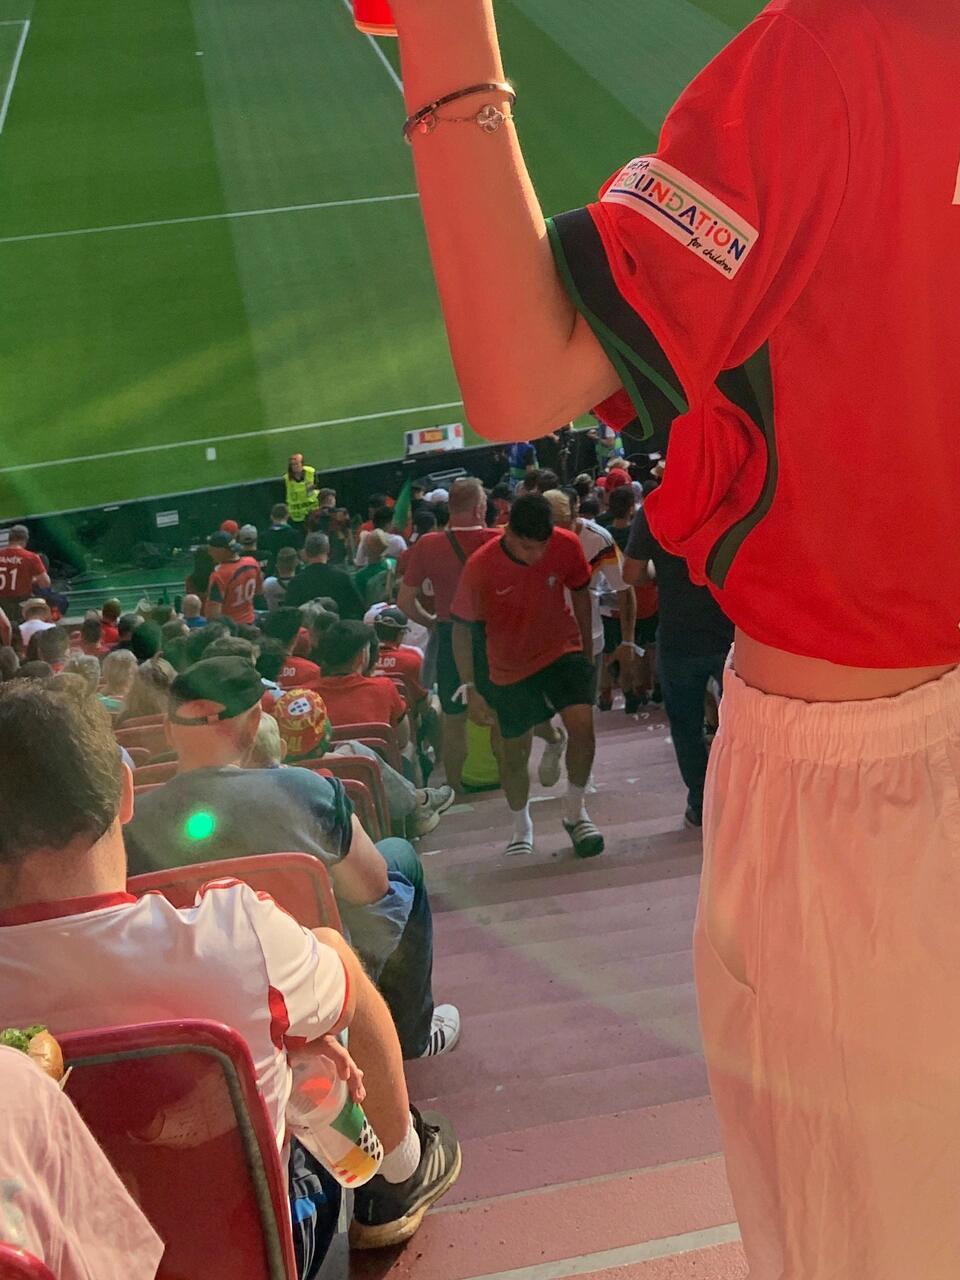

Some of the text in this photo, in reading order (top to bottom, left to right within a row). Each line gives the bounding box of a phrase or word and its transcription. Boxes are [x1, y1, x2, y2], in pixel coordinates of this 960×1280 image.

[613, 172, 746, 261] FOUNDATION
[687, 236, 733, 274] for children
[232, 578, 257, 607] 10
